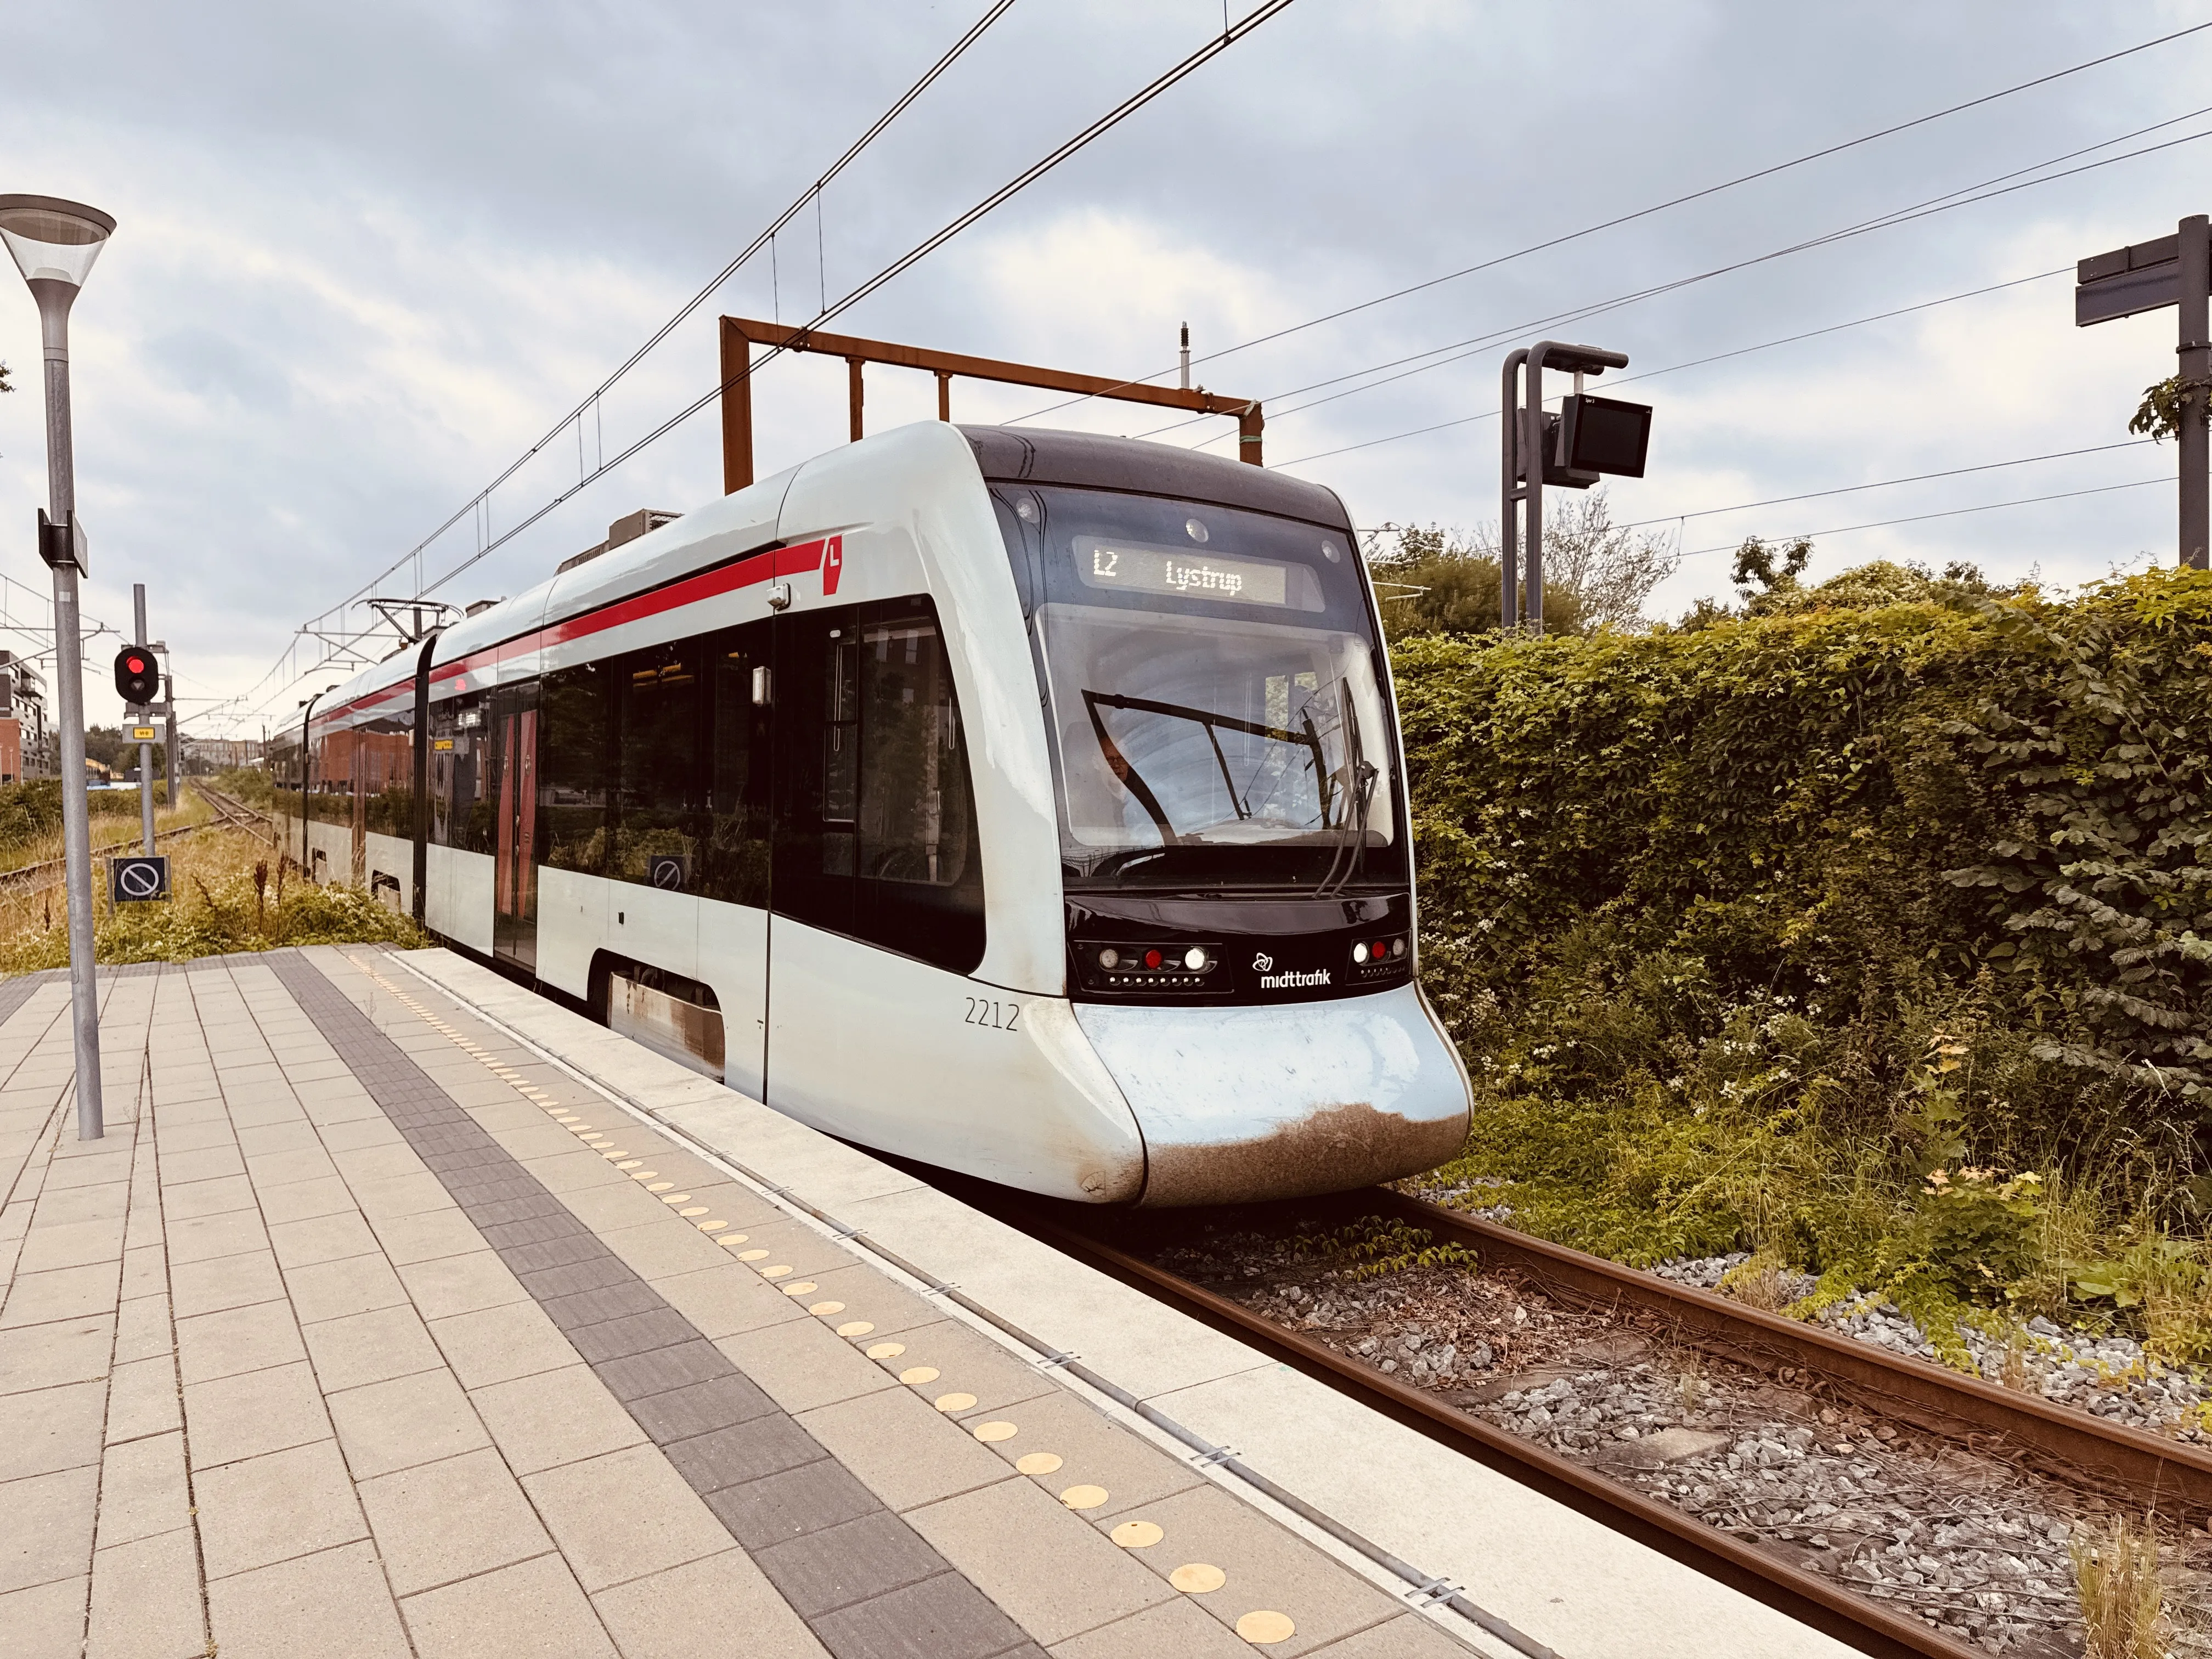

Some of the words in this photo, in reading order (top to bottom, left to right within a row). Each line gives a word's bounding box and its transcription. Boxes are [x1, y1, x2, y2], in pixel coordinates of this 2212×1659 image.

[1093, 550, 1118, 577] L2
[1166, 561, 1242, 596] Lystrup
[1261, 968, 1331, 989] midttrafik
[965, 997, 1019, 1031] 2212
